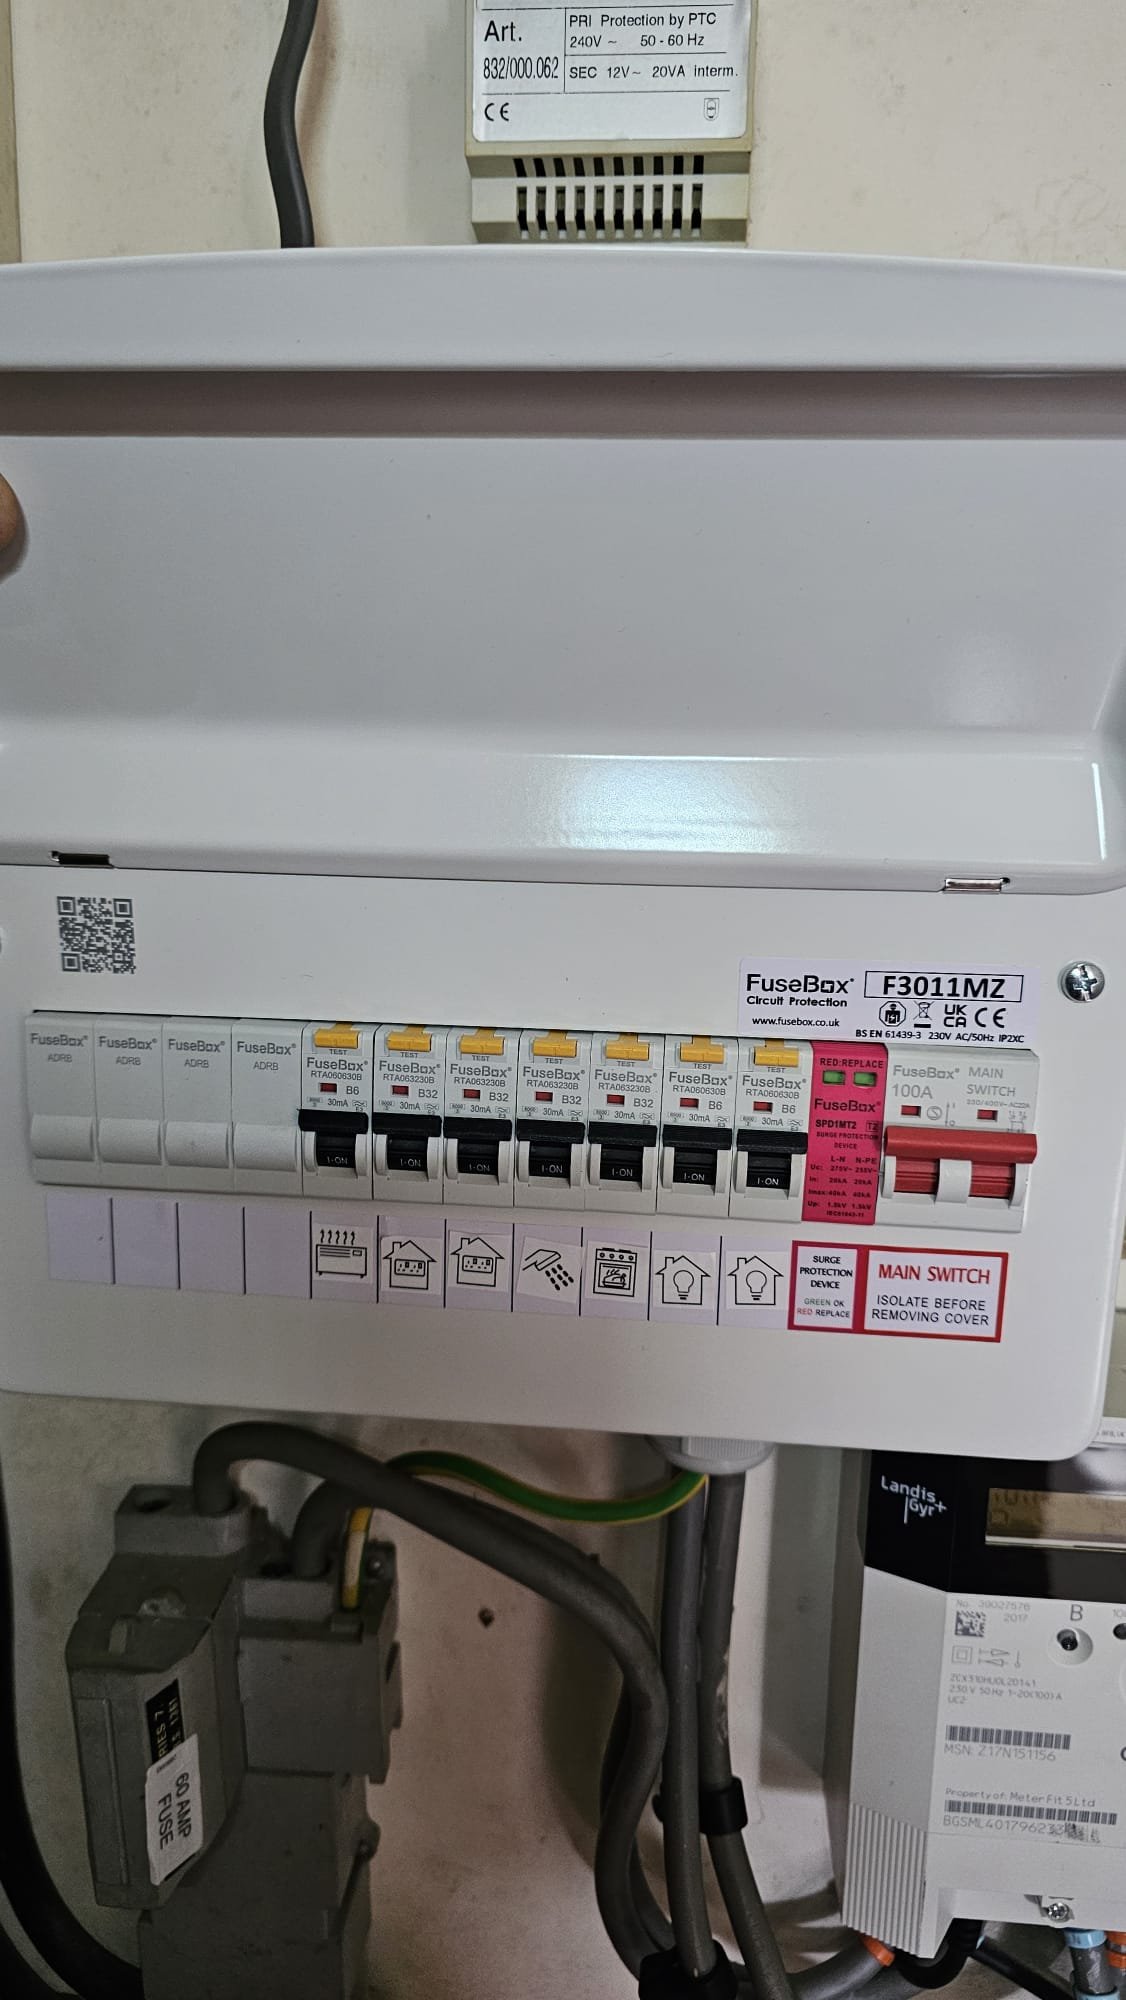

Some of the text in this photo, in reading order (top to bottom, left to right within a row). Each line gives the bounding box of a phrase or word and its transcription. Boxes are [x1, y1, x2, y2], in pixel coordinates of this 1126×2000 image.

[569, 12, 717, 29] PRI Protection by PTC
[484, 20, 523, 42] Art.
[570, 35, 602, 48] 240V
[640, 34, 656, 47] 50
[667, 33, 684, 46] 60
[687, 33, 705, 46] Hz
[483, 56, 559, 80] 832/000.062
[569, 67, 597, 79] SEC
[652, 65, 686, 78] 20VA
[694, 65, 739, 78] interm.
[883, 975, 1006, 998] F3011MZ
[746, 995, 848, 1008] Circuit Protection
[752, 1017, 840, 1028] www.fusebox.co.uk
[855, 1029, 1024, 1044] BS EN 61439-3 230V AC/50Hz IP2XC
[48, 1053, 72, 1063] ADRB
[116, 1056, 141, 1066] ADRB
[184, 1058, 209, 1069] ADRB
[253, 1061, 279, 1071] ADRB
[820, 1058, 884, 1069] RED:REPLACE
[968, 1067, 1004, 1079] MAIN
[346, 1086, 359, 1095] B6
[418, 1089, 438, 1098] B32
[892, 1083, 933, 1099] 100A
[967, 1084, 1016, 1097] SWITCH
[489, 1092, 509, 1102] B32
[562, 1095, 581, 1104] B32
[328, 1098, 348, 1107] 30mA
[400, 1101, 420, 1110] 30mA
[634, 1098, 654, 1108] B32
[709, 1101, 722, 1110] B6
[470, 1105, 491, 1113] 30mA
[543, 1107, 563, 1116] 30mA
[782, 1104, 795, 1113] B6
[615, 1110, 635, 1119] 30mA
[689, 1114, 710, 1122] 30mA
[762, 1117, 783, 1126] 30mA
[815, 1119, 857, 1130] SPD1MT2
[839, 1132, 879, 1140] PROTECTION
[834, 1142, 857, 1150] DEVICE
[855, 1156, 877, 1165] N-PE
[813, 1255, 841, 1265] SURGE
[800, 1267, 853, 1277] PROTECTION
[878, 1263, 990, 1284] MAIN SWITCH
[810, 1280, 840, 1289] DEVICE
[804, 1297, 845, 1307] GREEN OK
[877, 1294, 986, 1311] ISOLATE BEFORE
[797, 1308, 850, 1318] RED REPLACE
[871, 1308, 989, 1326] REMOVING COVER
[881, 1475, 936, 1503] Landis
[1003, 1613, 1028, 1622] 2017
[1070, 1604, 1083, 1621] B
[978, 1745, 1056, 1761] Z17N151156
[945, 1788, 990, 1800] Property
[176, 1772, 192, 1838] 60 AMP
[158, 1792, 174, 1850] FUSE
